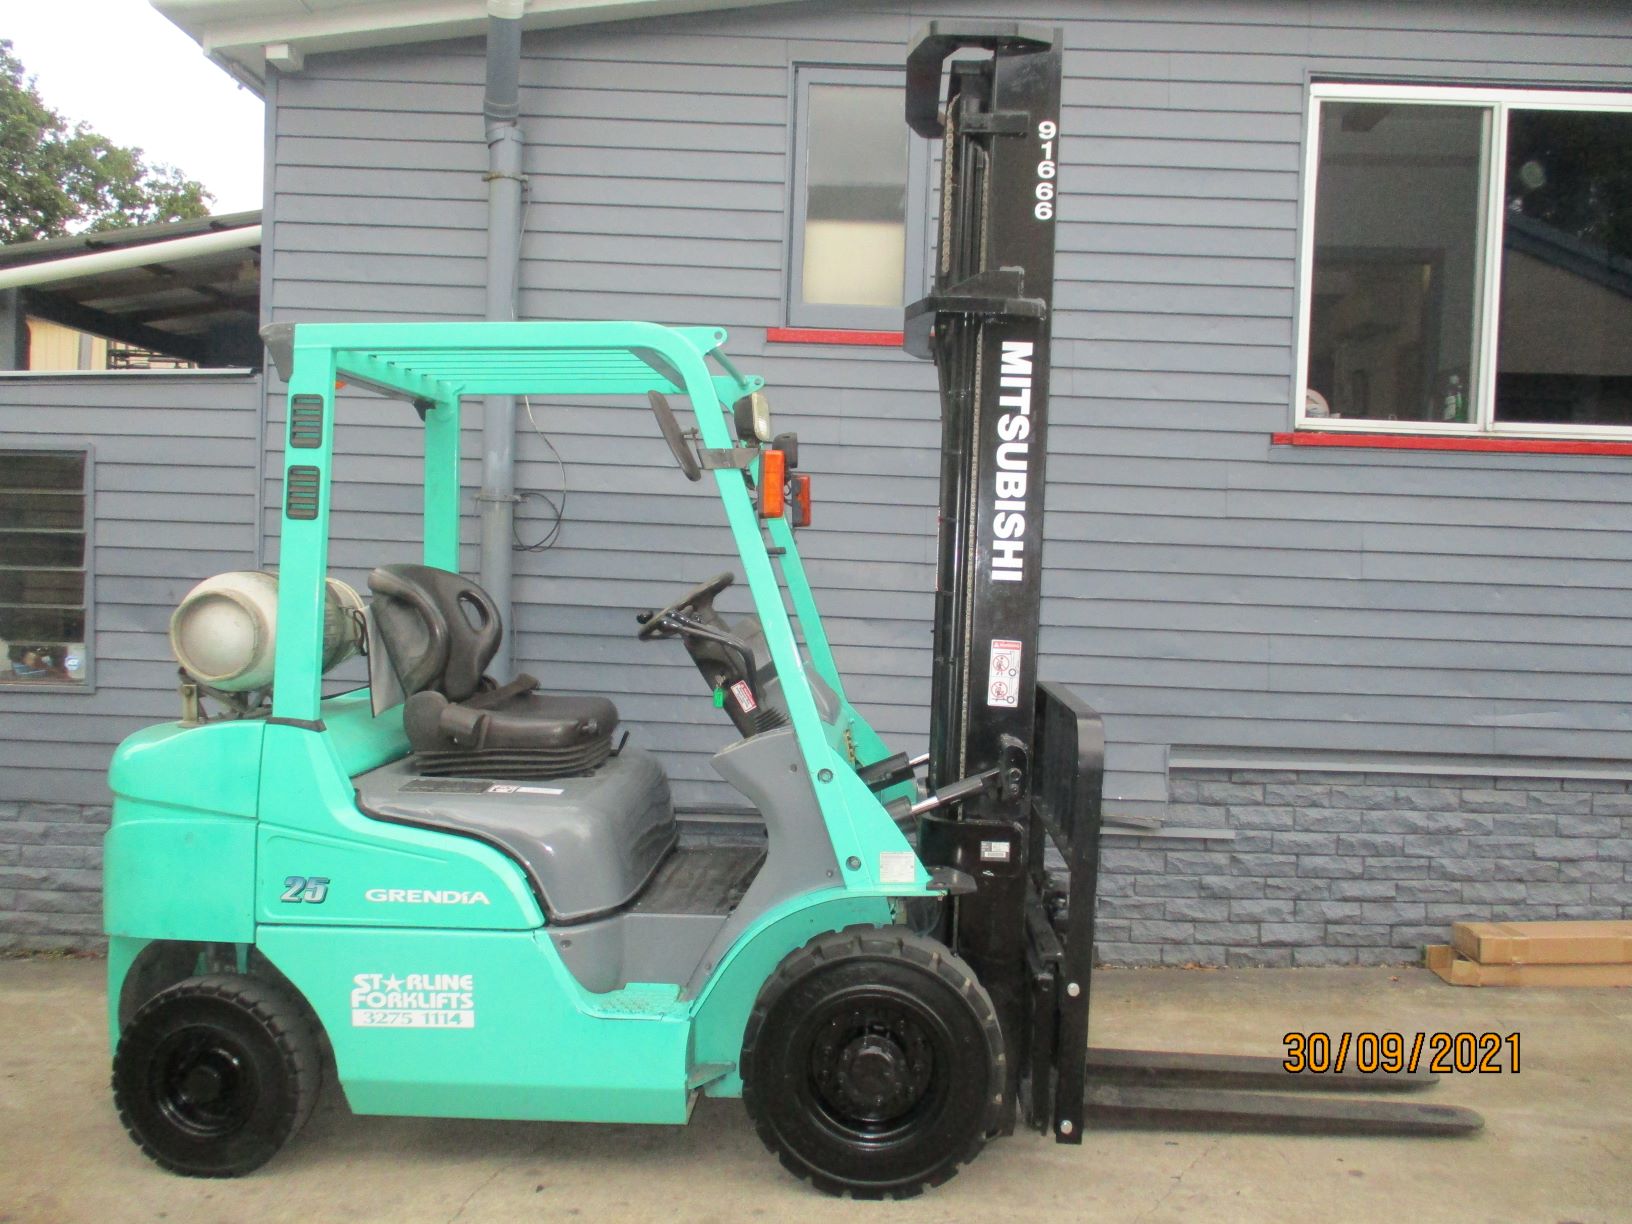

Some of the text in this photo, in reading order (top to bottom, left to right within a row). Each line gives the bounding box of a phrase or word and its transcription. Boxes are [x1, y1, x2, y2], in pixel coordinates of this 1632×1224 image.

[1034, 120, 1057, 220] 91666
[991, 341, 1034, 582] MITSUBISHI
[280, 875, 330, 904] 25
[351, 989, 475, 1009] FORKLIFTS
[363, 1011, 464, 1025] 3275 1114
